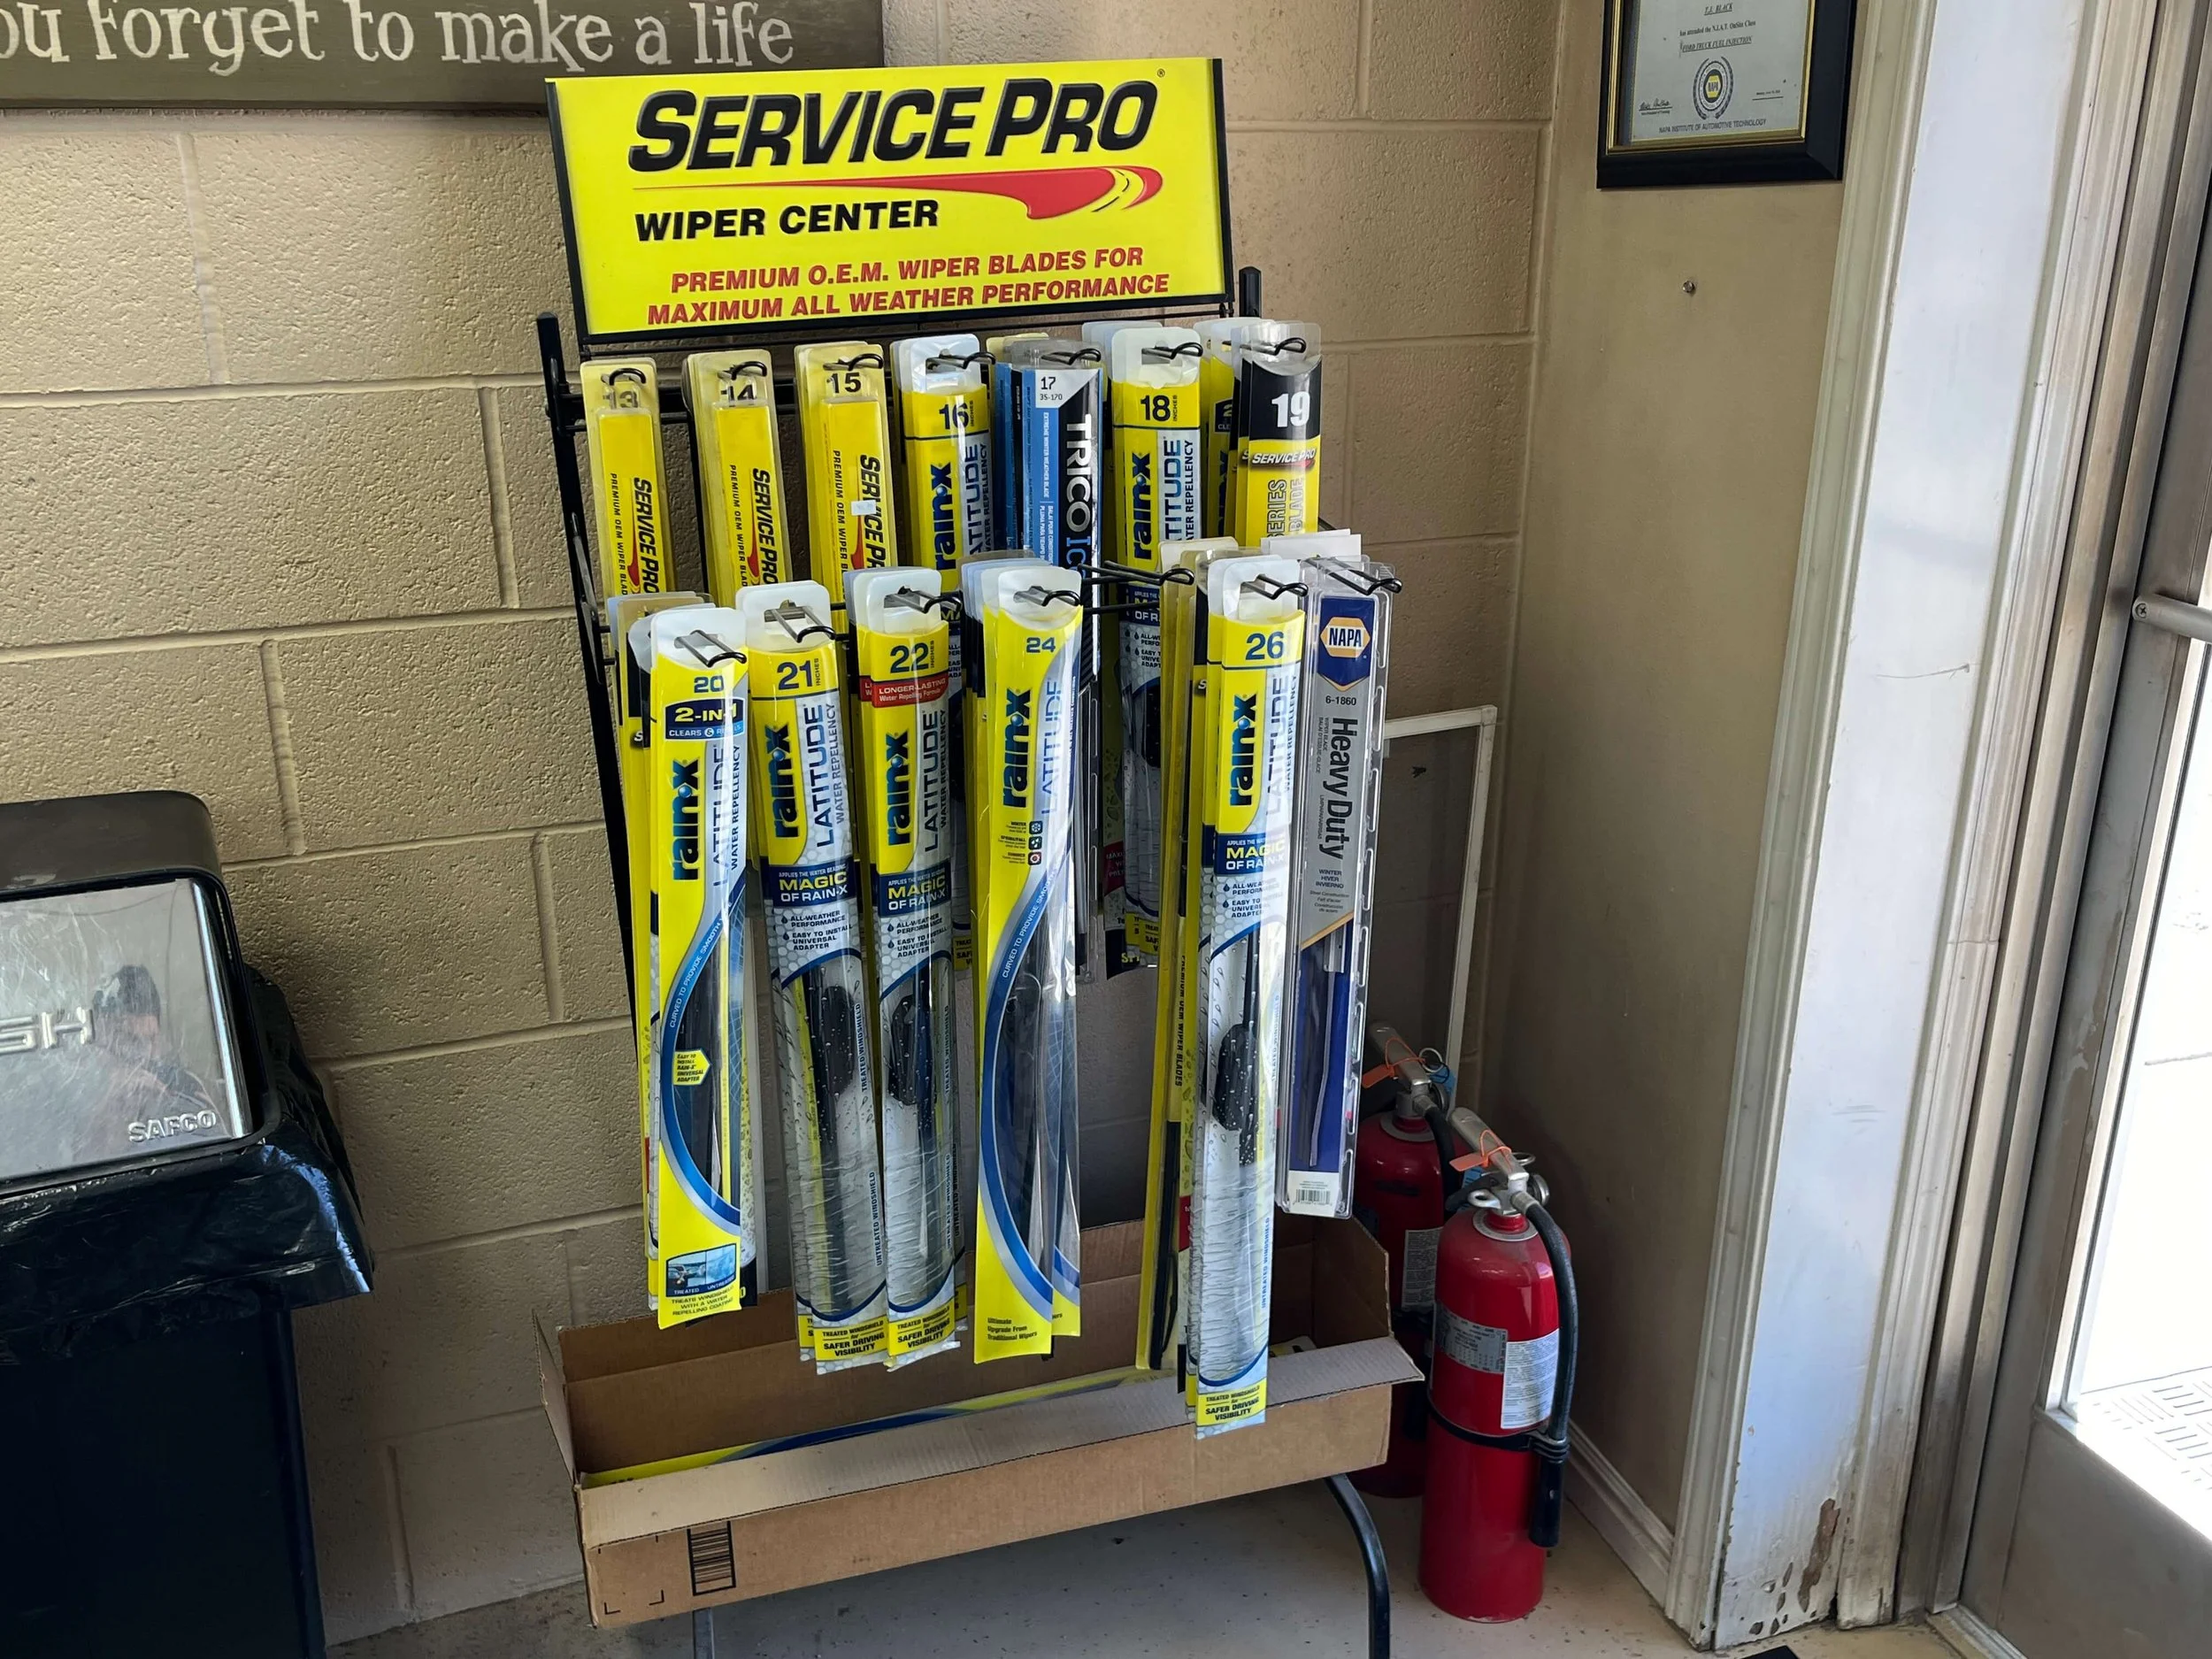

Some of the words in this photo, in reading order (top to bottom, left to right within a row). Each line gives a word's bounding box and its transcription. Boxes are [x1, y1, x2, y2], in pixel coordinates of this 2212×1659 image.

[349, 0, 415, 61] to
[434, 0, 614, 73] make
[634, 15, 672, 65] a
[688, 1, 794, 66] life
[627, 87, 987, 173] SERVICE
[986, 78, 1159, 157] PRO
[1733, 119, 1767, 128] TECHNOLOGY
[634, 207, 766, 242] WIPER
[779, 199, 940, 234] CENTER
[671, 266, 800, 294] PREMIUM
[807, 261, 890, 287] O.E.M.
[898, 256, 979, 280] WIPER
[987, 250, 1087, 275] BLADES
[1094, 247, 1144, 268] FOR
[647, 296, 785, 326] MAXIMUM
[790, 293, 843, 317] ALL
[849, 286, 974, 313] WEATHER
[980, 274, 1170, 305] PERFORMANCE
[720, 384, 758, 408] 14
[826, 372, 863, 394] 15
[1040, 376, 1056, 390] 17
[939, 403, 970, 430] 16
[1141, 395, 1171, 422] 18
[1271, 392, 1311, 428] 19
[1252, 452, 1298, 464] SERVICE
[729, 464, 741, 508] PREMIUM
[833, 449, 844, 500] PREMIUM
[979, 444, 990, 516] REPELLENCY
[1065, 414, 1092, 533] TRICO
[1184, 441, 1194, 512] REPELLENCY
[610, 472, 621, 517] PREMIUM
[964, 444, 983, 555] ATITUDE
[1163, 440, 1182, 541] TITUDE
[634, 477, 657, 556] SERVICE
[733, 510, 743, 531] OEM
[751, 467, 775, 549] SERVICE
[836, 501, 846, 525] OEM
[614, 518, 623, 539] OEM
[838, 526, 849, 560] WIPER
[616, 541, 626, 572] WIPER
[736, 533, 747, 562] WIPER
[1134, 611, 1149, 620] OF
[1025, 636, 1056, 653] 24
[1246, 631, 1285, 661] 26
[1329, 626, 1362, 647] NAPA
[890, 642, 929, 673] 22
[694, 675, 725, 694] 20
[777, 661, 813, 690] 21
[1286, 676, 1297, 750] REPELLENCY
[1325, 695, 1357, 706] 6-1860
[825, 703, 841, 780] REPELLENCY
[1323, 718, 1358, 797] Heavy
[732, 745, 741, 820] REPELLENCY
[803, 704, 834, 849] LATITUDE
[922, 710, 939, 852] LATITUDE
[833, 782, 845, 824] WATER
[1319, 799, 1353, 860] Duty
[730, 822, 740, 871] WATER
[1225, 860, 1244, 871] OF
[779, 872, 848, 891] MAGIC
[887, 874, 946, 900] MAGIC
[780, 893, 800, 902] OF
[887, 900, 907, 911] OF
[790, 910, 841, 922] ALL-WEATHER
[791, 915, 846, 928] PERFORMANCE
[793, 935, 837, 945] UNIVERSAL
[794, 942, 830, 951] ADAPTER
[897, 946, 929, 958] ADAPTER
[1002, 949, 1018, 979] CURVED
[1014, 936, 1023, 950] TO
[1019, 906, 1039, 937] PROVIDE
[669, 999, 683, 1029] CURVED
[679, 985, 687, 997] TO
[683, 956, 703, 986] PROVIDE
[700, 922, 722, 955] SMOOTH
[854, 1002, 864, 1055] WINDSHIELD
[858, 1056, 868, 1093] TREATED
[128, 1109, 218, 1144] SAFCO
[869, 1171, 879, 1219] WINDSHIELD
[872, 1221, 883, 1267] UNTREATED
[849, 1319, 885, 1334] WINDSHIELD
[897, 1319, 921, 1330] TREATED
[897, 1332, 923, 1343] SAFER
[987, 1325, 1011, 1335] Upgrade
[987, 1333, 1018, 1341] Traditional
[1018, 1331, 1038, 1340] Wipers
[824, 1340, 850, 1350] SAFER
[852, 1333, 885, 1347] DRIVING
[834, 1342, 877, 1356] VISIBILITY
[907, 1332, 944, 1348] VISIBILITY
[1205, 1406, 1230, 1415] SAFER
[1214, 1408, 1252, 1421] VISIBILITY
